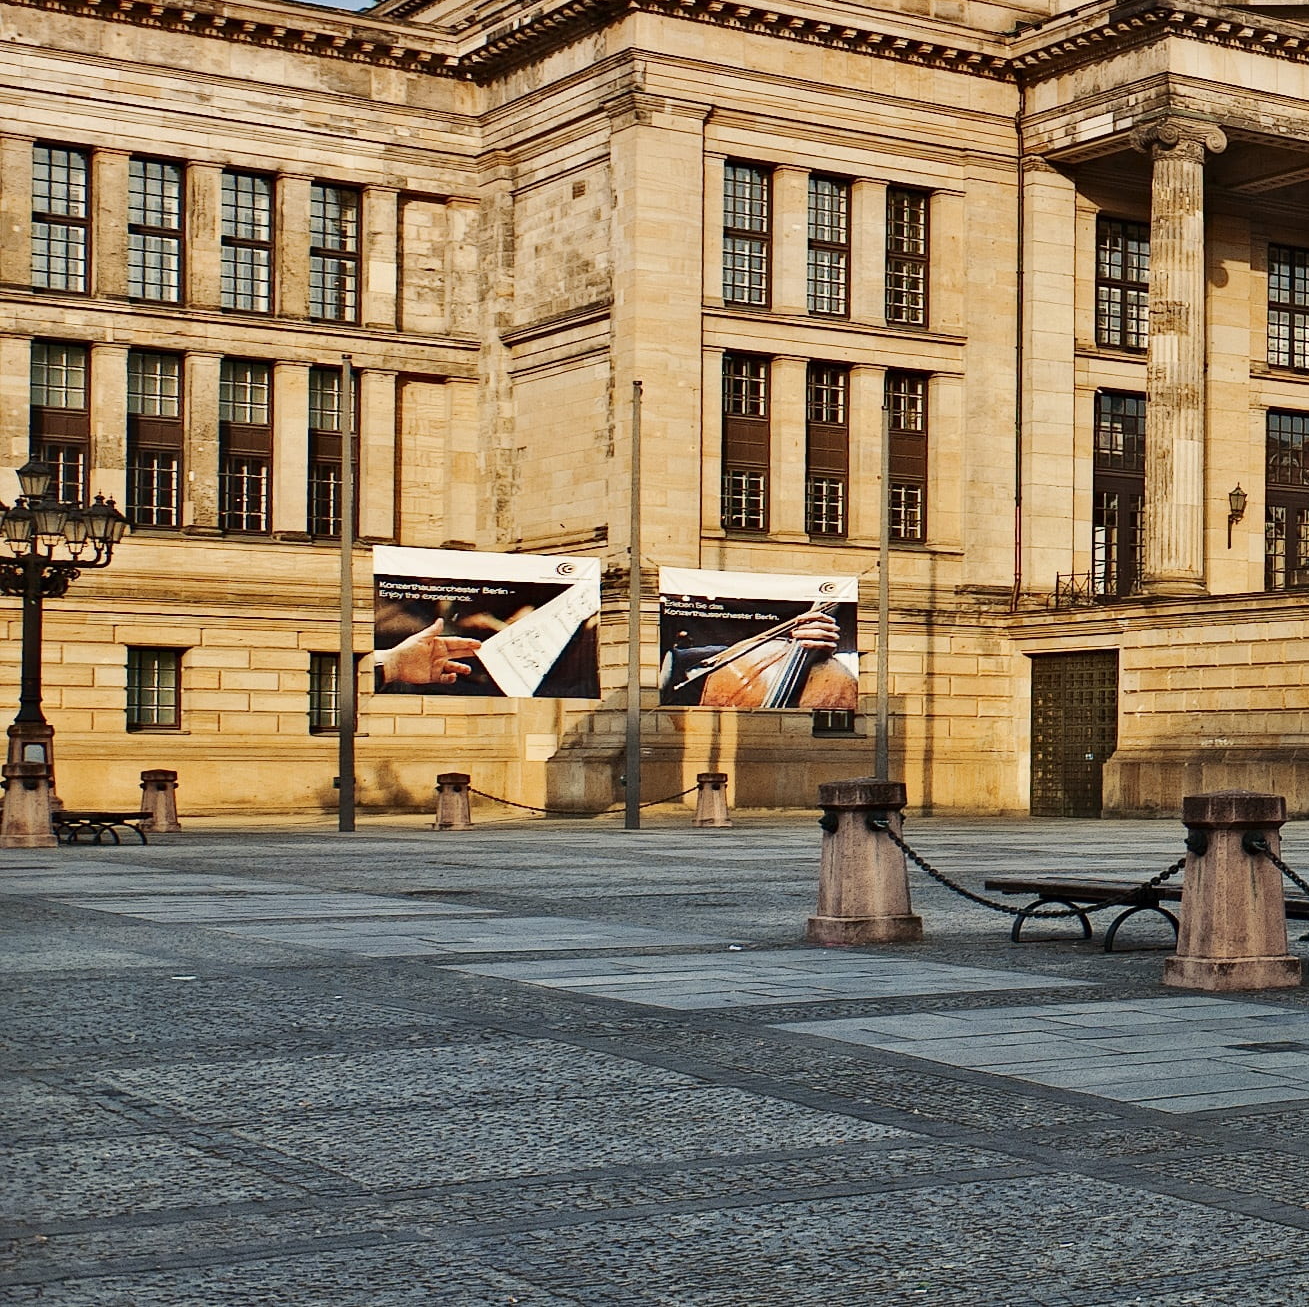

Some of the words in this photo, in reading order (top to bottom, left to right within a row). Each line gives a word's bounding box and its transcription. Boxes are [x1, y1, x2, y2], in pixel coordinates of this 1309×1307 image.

[379, 589, 404, 600] Enjoy
[405, 592, 420, 600] the
[482, 586, 508, 595] Berlin
